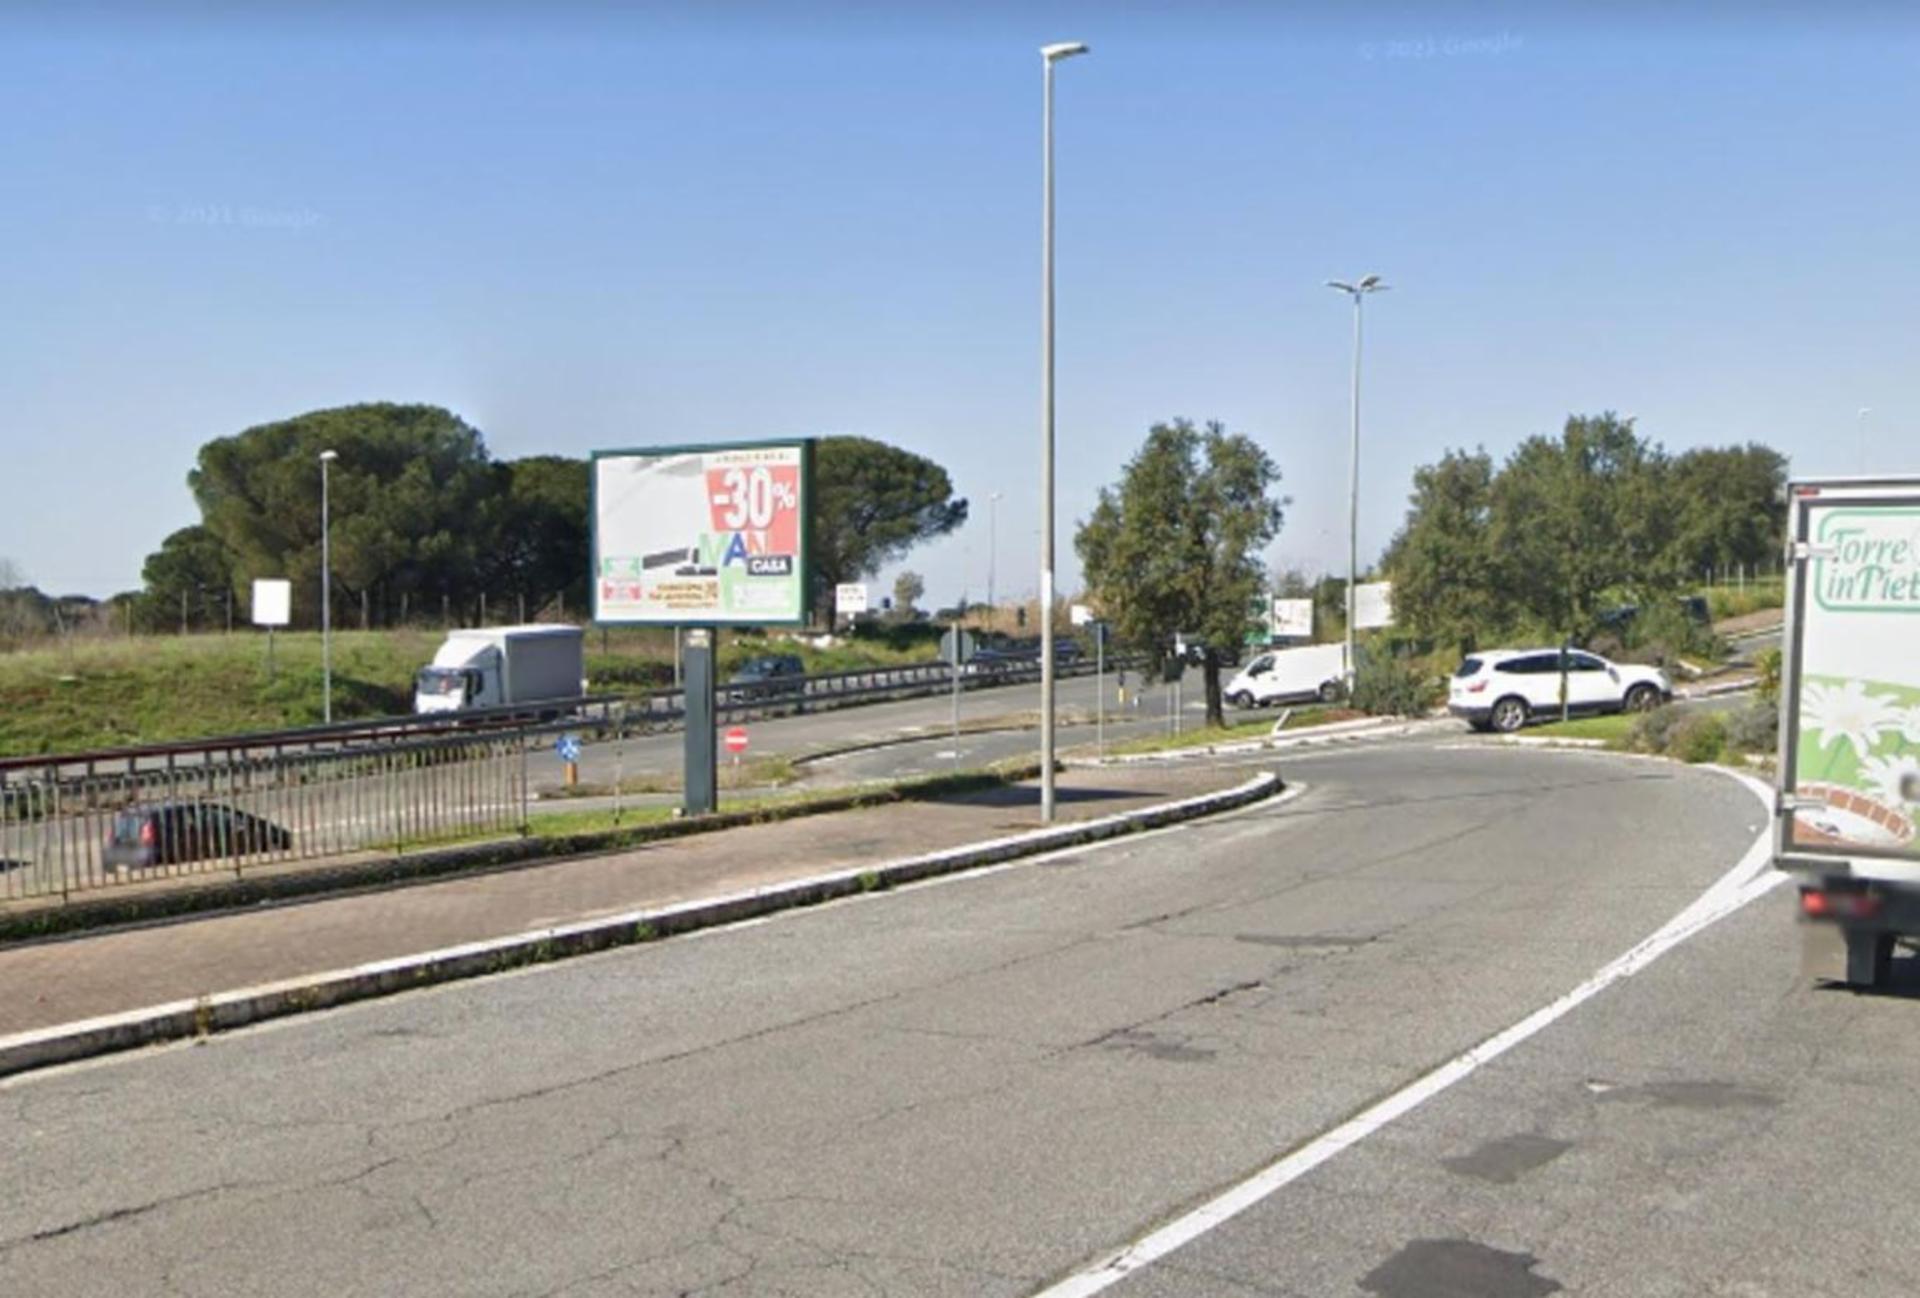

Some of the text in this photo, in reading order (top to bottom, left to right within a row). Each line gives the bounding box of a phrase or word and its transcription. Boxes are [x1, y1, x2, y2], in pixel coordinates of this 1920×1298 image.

[713, 466, 796, 530] -30%
[1828, 528, 1908, 564] Torre
[1828, 568, 1854, 600] in
